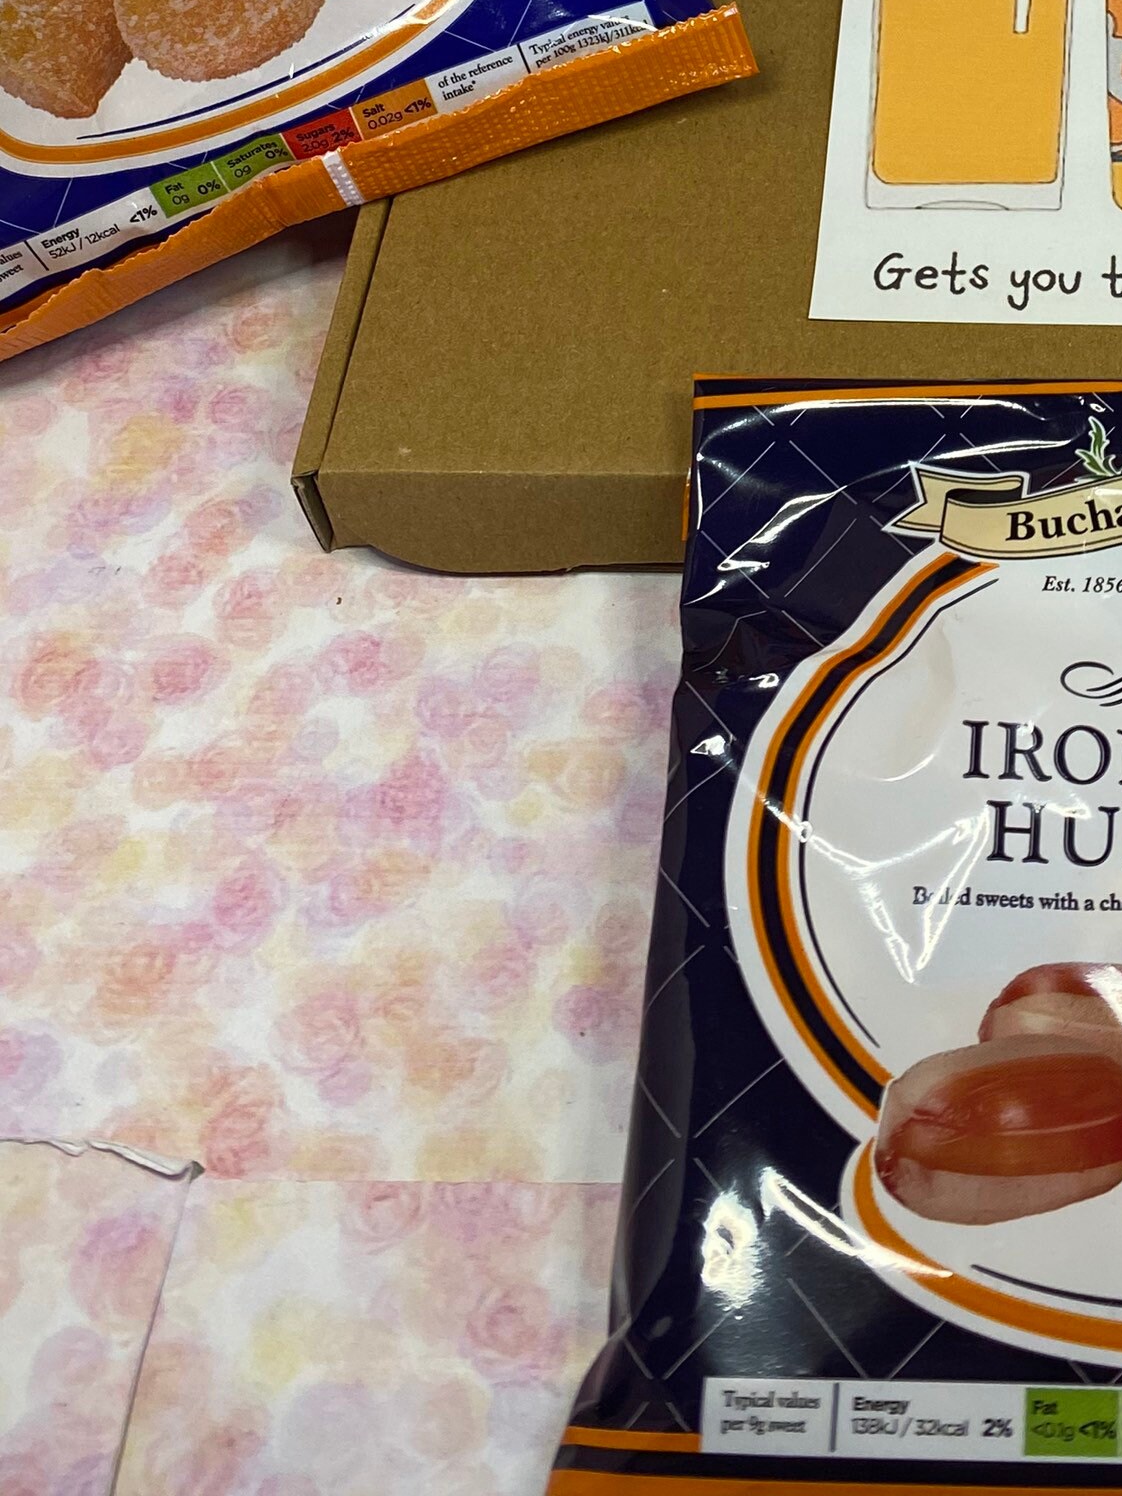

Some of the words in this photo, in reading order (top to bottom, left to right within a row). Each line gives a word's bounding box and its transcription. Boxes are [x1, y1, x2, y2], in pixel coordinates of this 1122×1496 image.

[567, 23, 597, 40] energy
[535, 55, 552, 68] per
[554, 44, 577, 58] 100g
[438, 76, 449, 89] of
[450, 71, 468, 85] the
[468, 55, 513, 77] reference
[362, 103, 385, 118] Salt
[368, 110, 404, 130] 0.02g
[404, 97, 432, 114] <1%
[296, 123, 336, 141] Sugars
[302, 139, 330, 153] 2.0g
[333, 127, 355, 144] 2%
[227, 141, 278, 168] Saturates
[234, 165, 252, 178] 0g
[264, 146, 289, 159] 0%
[164, 181, 183, 195] Fat
[172, 193, 190, 206] 0g
[197, 179, 221, 195] 0%
[41, 228, 80, 249] Energy
[129, 205, 158, 224] <1%
[49, 242, 76, 259] 52kJ
[84, 223, 121, 244] 12kcal
[872, 251, 990, 295] Gets
[1007, 266, 1083, 312] you
[1042, 575, 1076, 593] Est.
[975, 893, 1034, 909] sweets
[1038, 892, 1080, 912] with
[1084, 897, 1095, 912] a
[721, 1389, 776, 1411] Typical
[852, 1396, 910, 1416] Energy
[1031, 1399, 1058, 1416] Fat
[981, 1418, 1013, 1438] 2%
